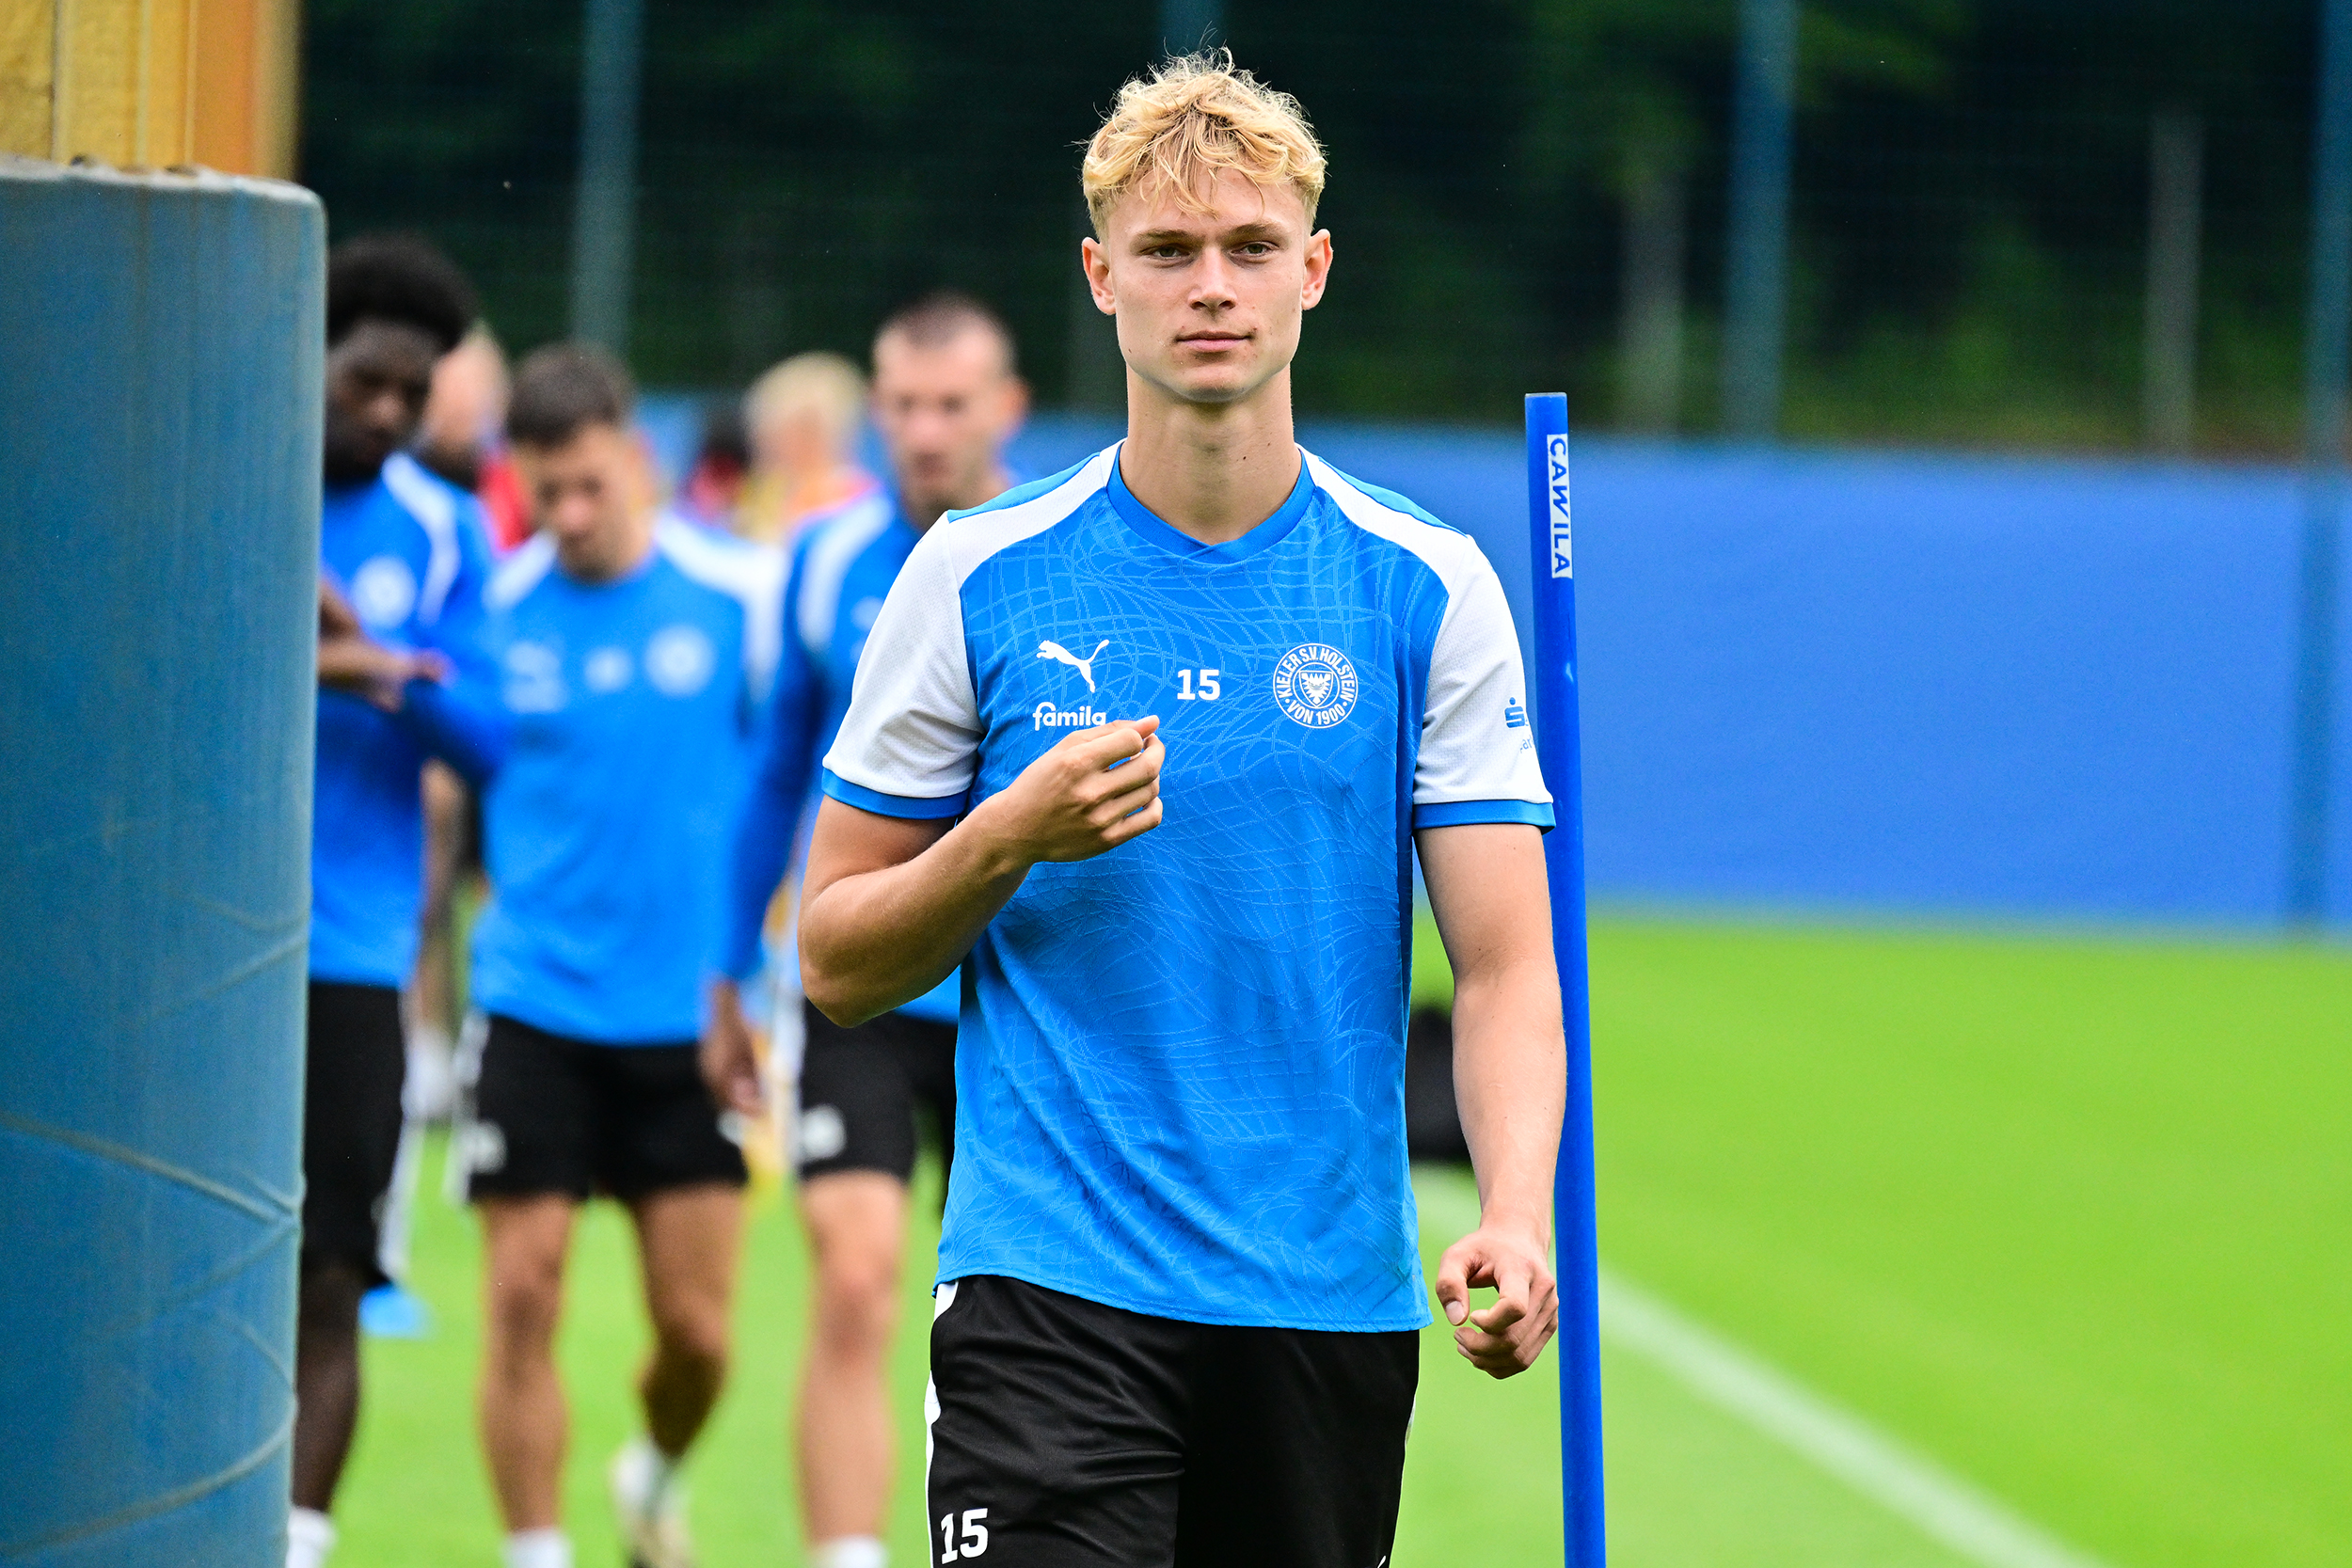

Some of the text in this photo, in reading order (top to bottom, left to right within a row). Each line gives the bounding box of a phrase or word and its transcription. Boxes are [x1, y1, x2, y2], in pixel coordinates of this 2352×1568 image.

[1550, 437, 1570, 574] CAWILA
[1177, 669, 1220, 701] 15
[1276, 653, 1302, 699] KIELER
[1320, 647, 1356, 703] HOLSTEIN
[1032, 701, 1106, 731] famila
[1287, 700, 1346, 725] VON 1900
[941, 1508, 989, 1565] 15
